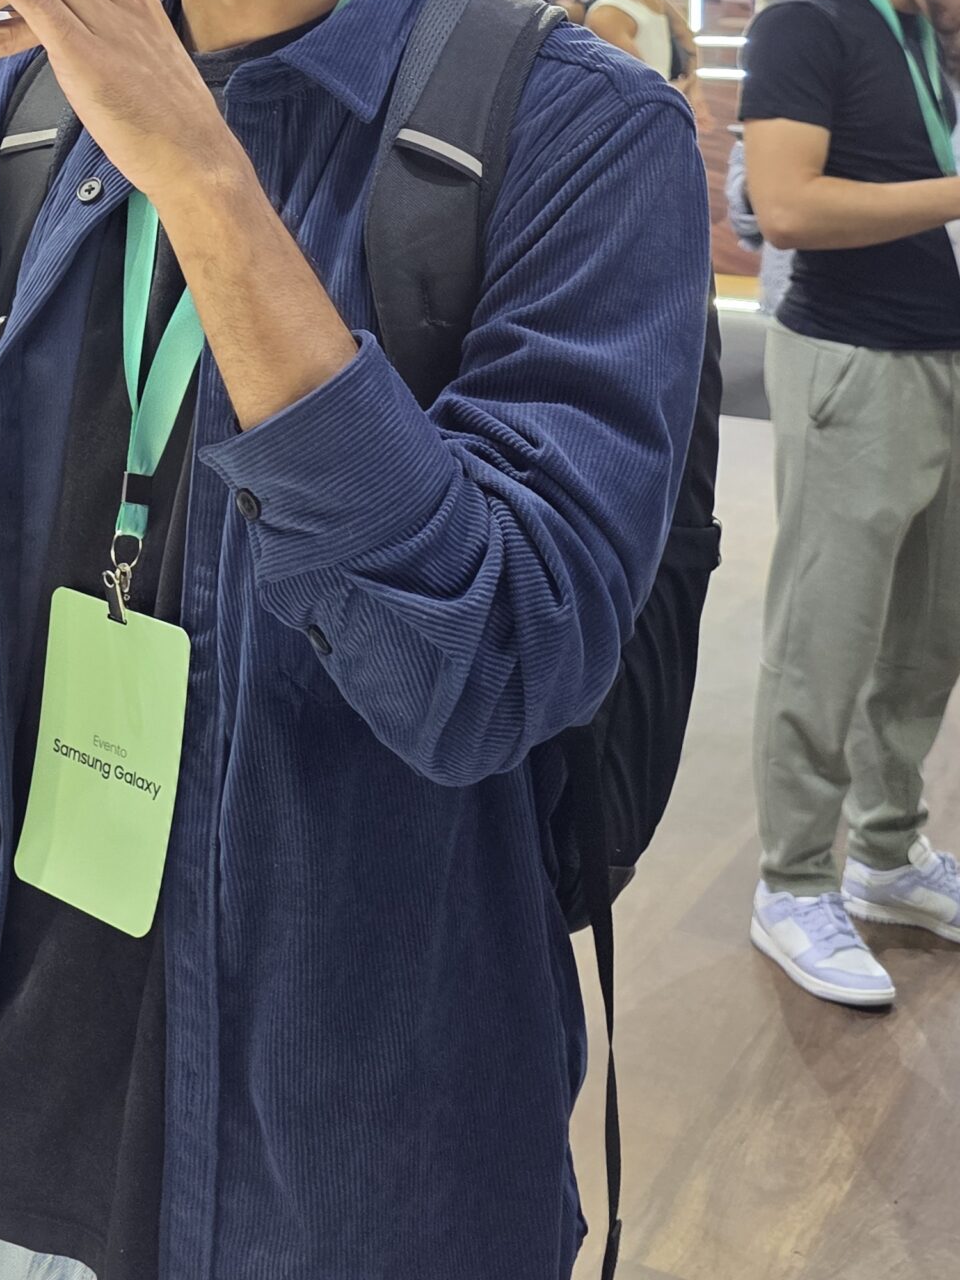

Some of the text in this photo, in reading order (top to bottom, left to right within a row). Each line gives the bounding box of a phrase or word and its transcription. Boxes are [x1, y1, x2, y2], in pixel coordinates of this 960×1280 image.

[93, 735, 127, 758] Evento
[53, 738, 161, 800] Samsung Galaxy
